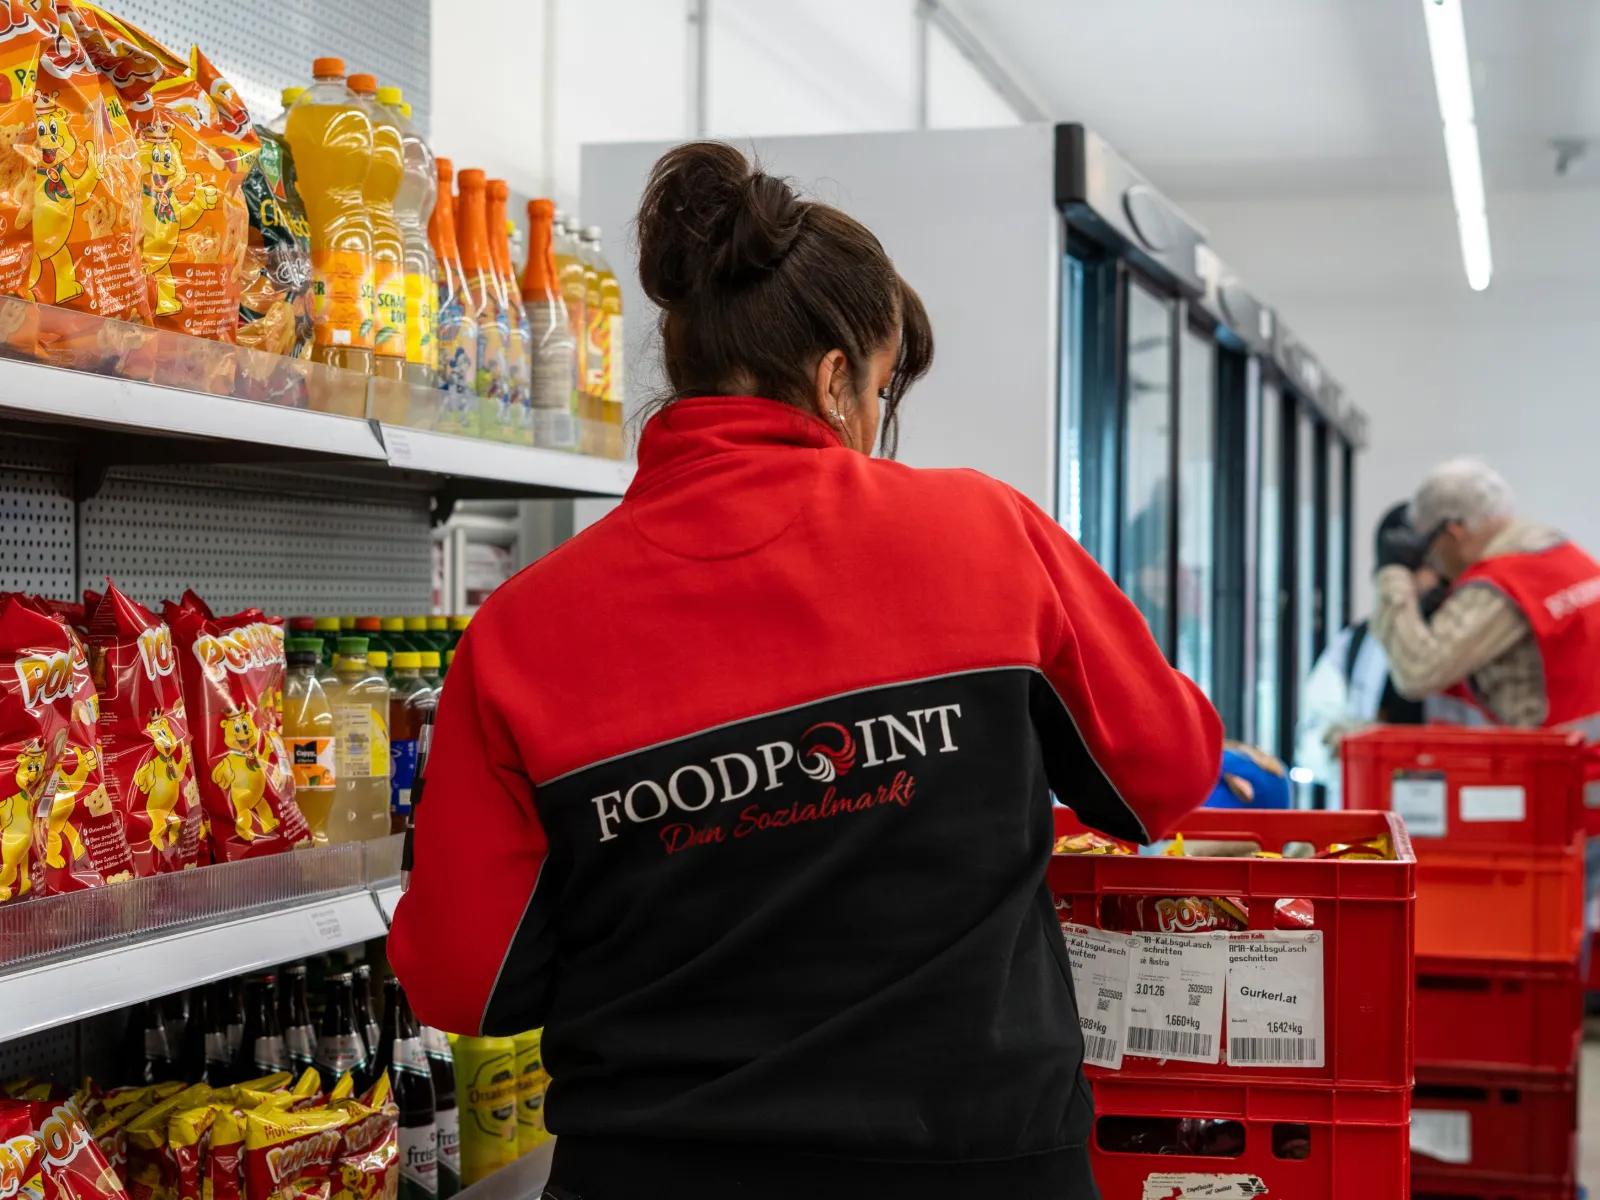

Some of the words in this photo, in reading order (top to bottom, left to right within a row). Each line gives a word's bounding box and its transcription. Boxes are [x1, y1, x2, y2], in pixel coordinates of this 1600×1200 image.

[591, 703, 962, 843] FOODPOINT
[734, 769, 916, 838] Sozialmarkt
[1229, 953, 1278, 964] geschnitten
[1240, 985, 1298, 1005] Gurkerl.at
